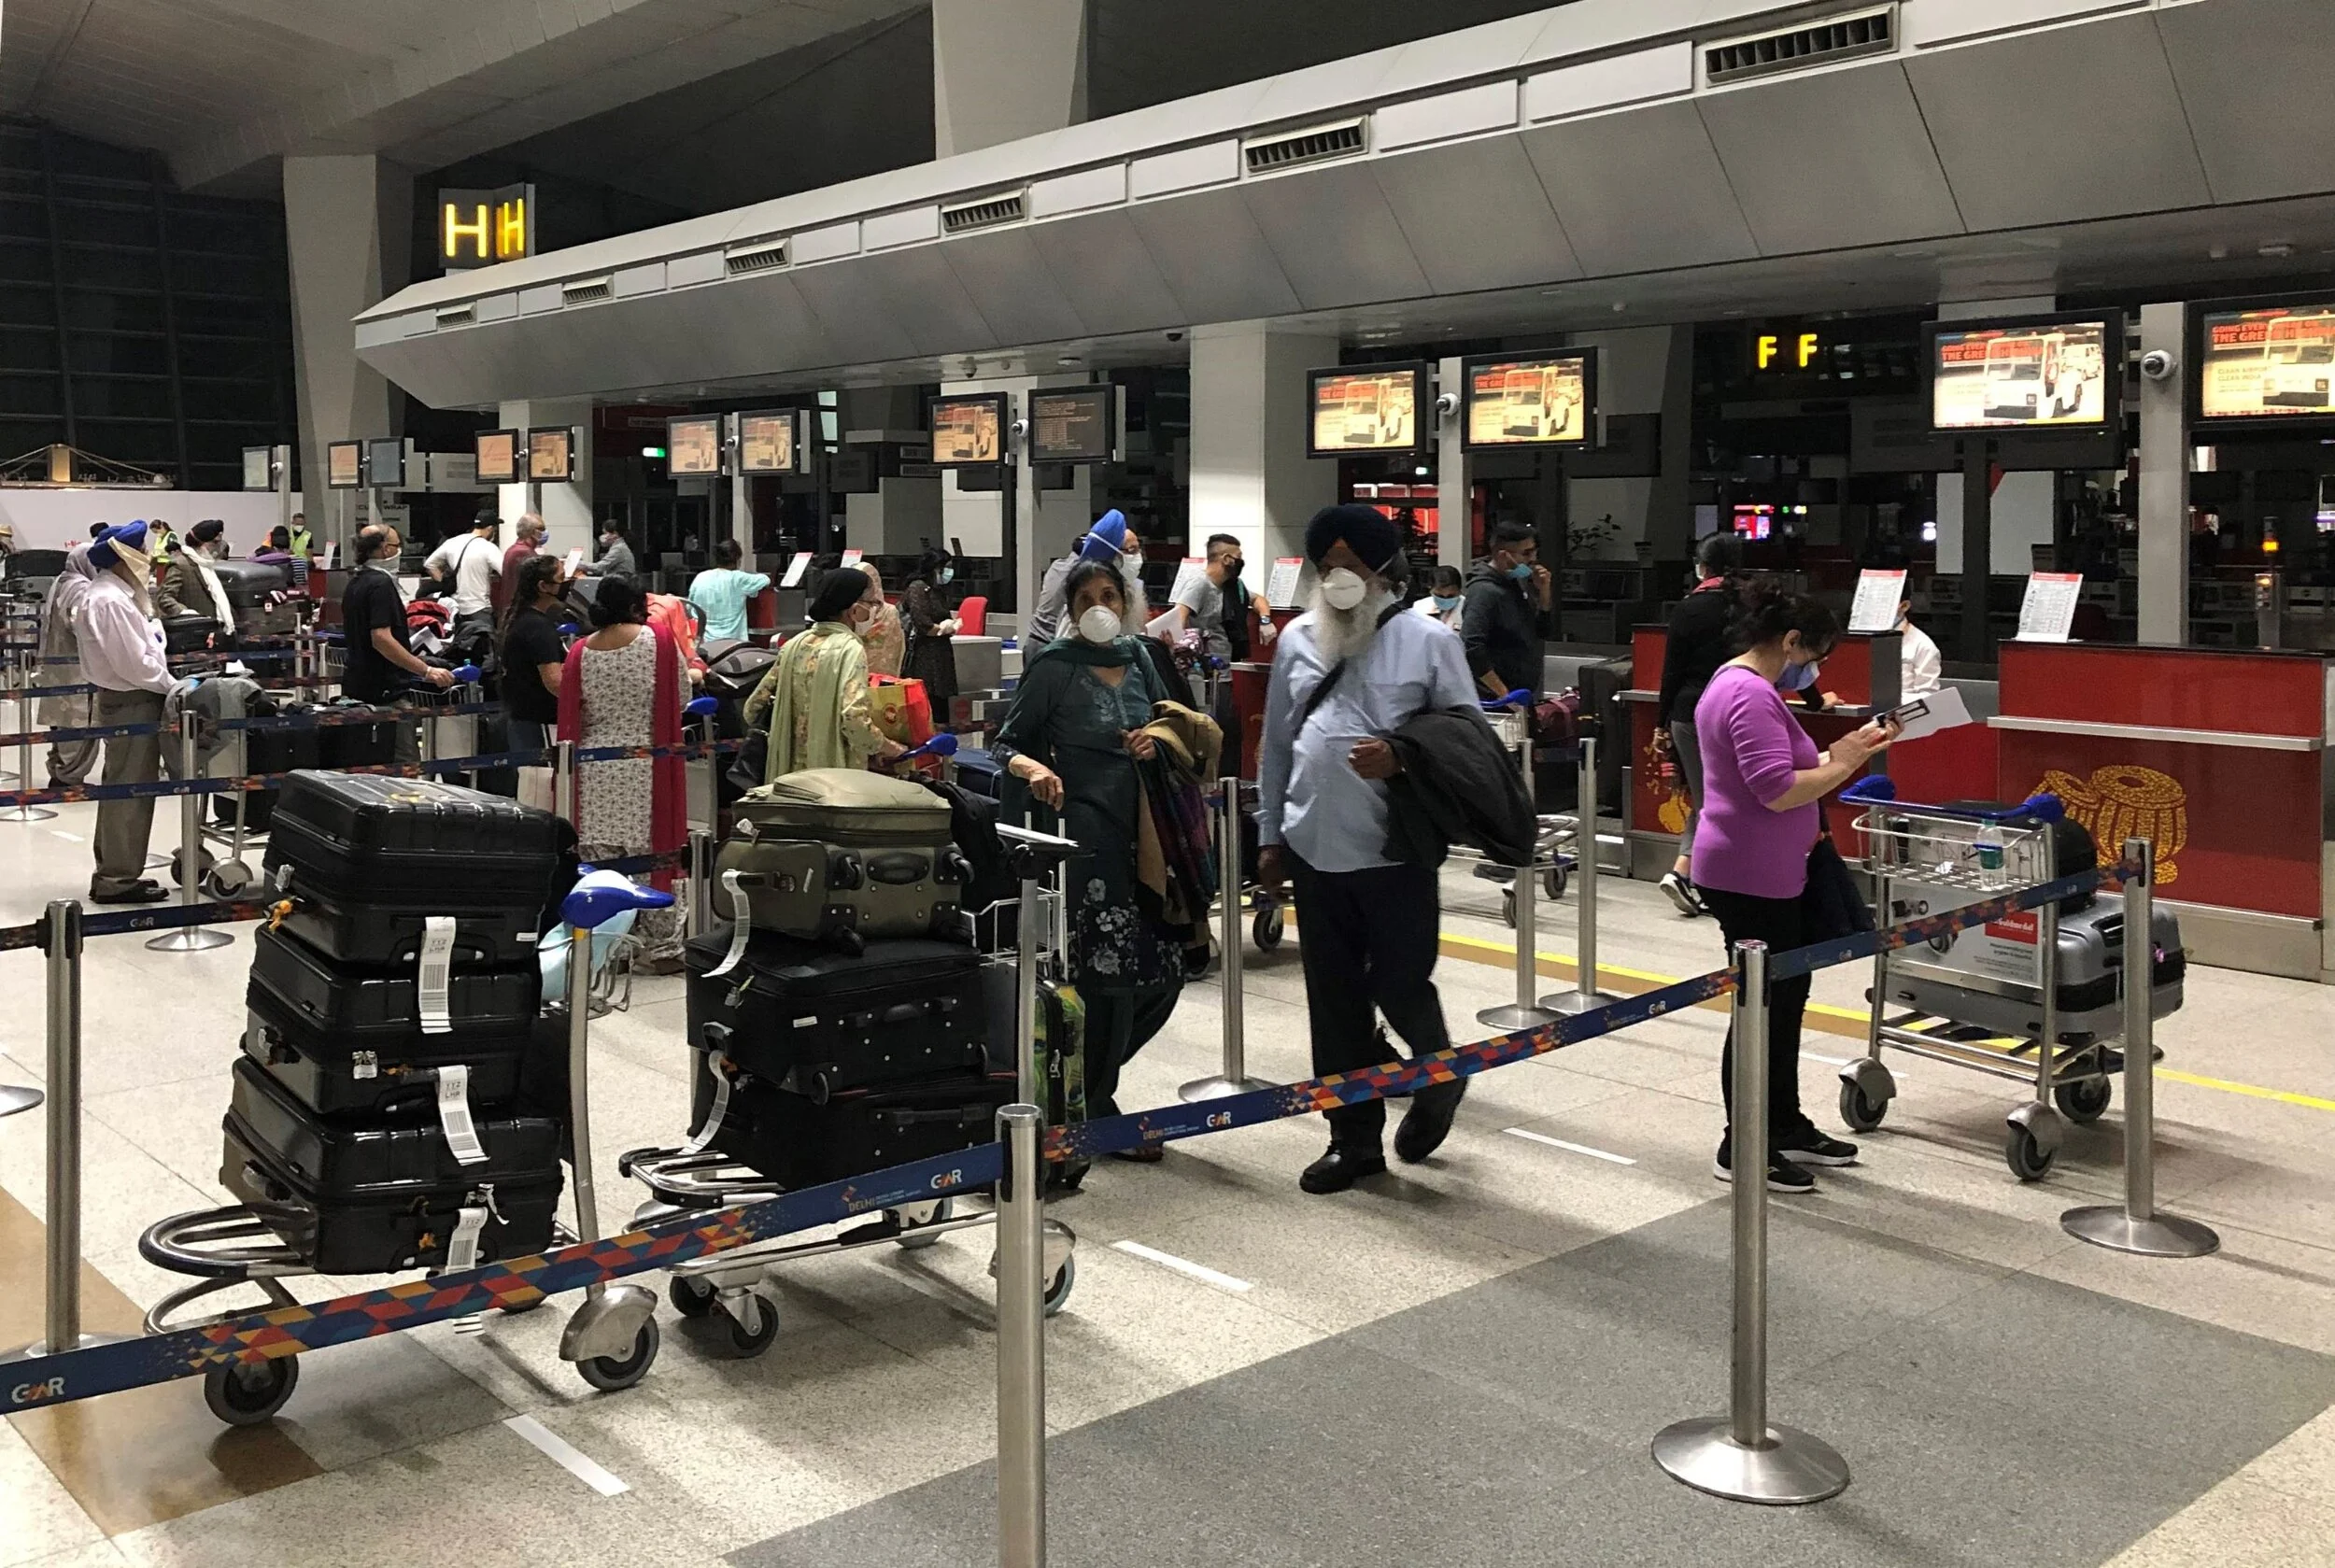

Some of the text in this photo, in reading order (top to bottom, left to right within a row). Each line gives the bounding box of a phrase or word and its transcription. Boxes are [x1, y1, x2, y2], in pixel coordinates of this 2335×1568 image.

[446, 204, 487, 257] H
[503, 198, 524, 254] H
[1759, 336, 1777, 369] F
[1800, 333, 1818, 367] F
[2212, 332, 2237, 344] THE
[1942, 351, 1962, 361] THE
[848, 1198, 876, 1212] DELHI
